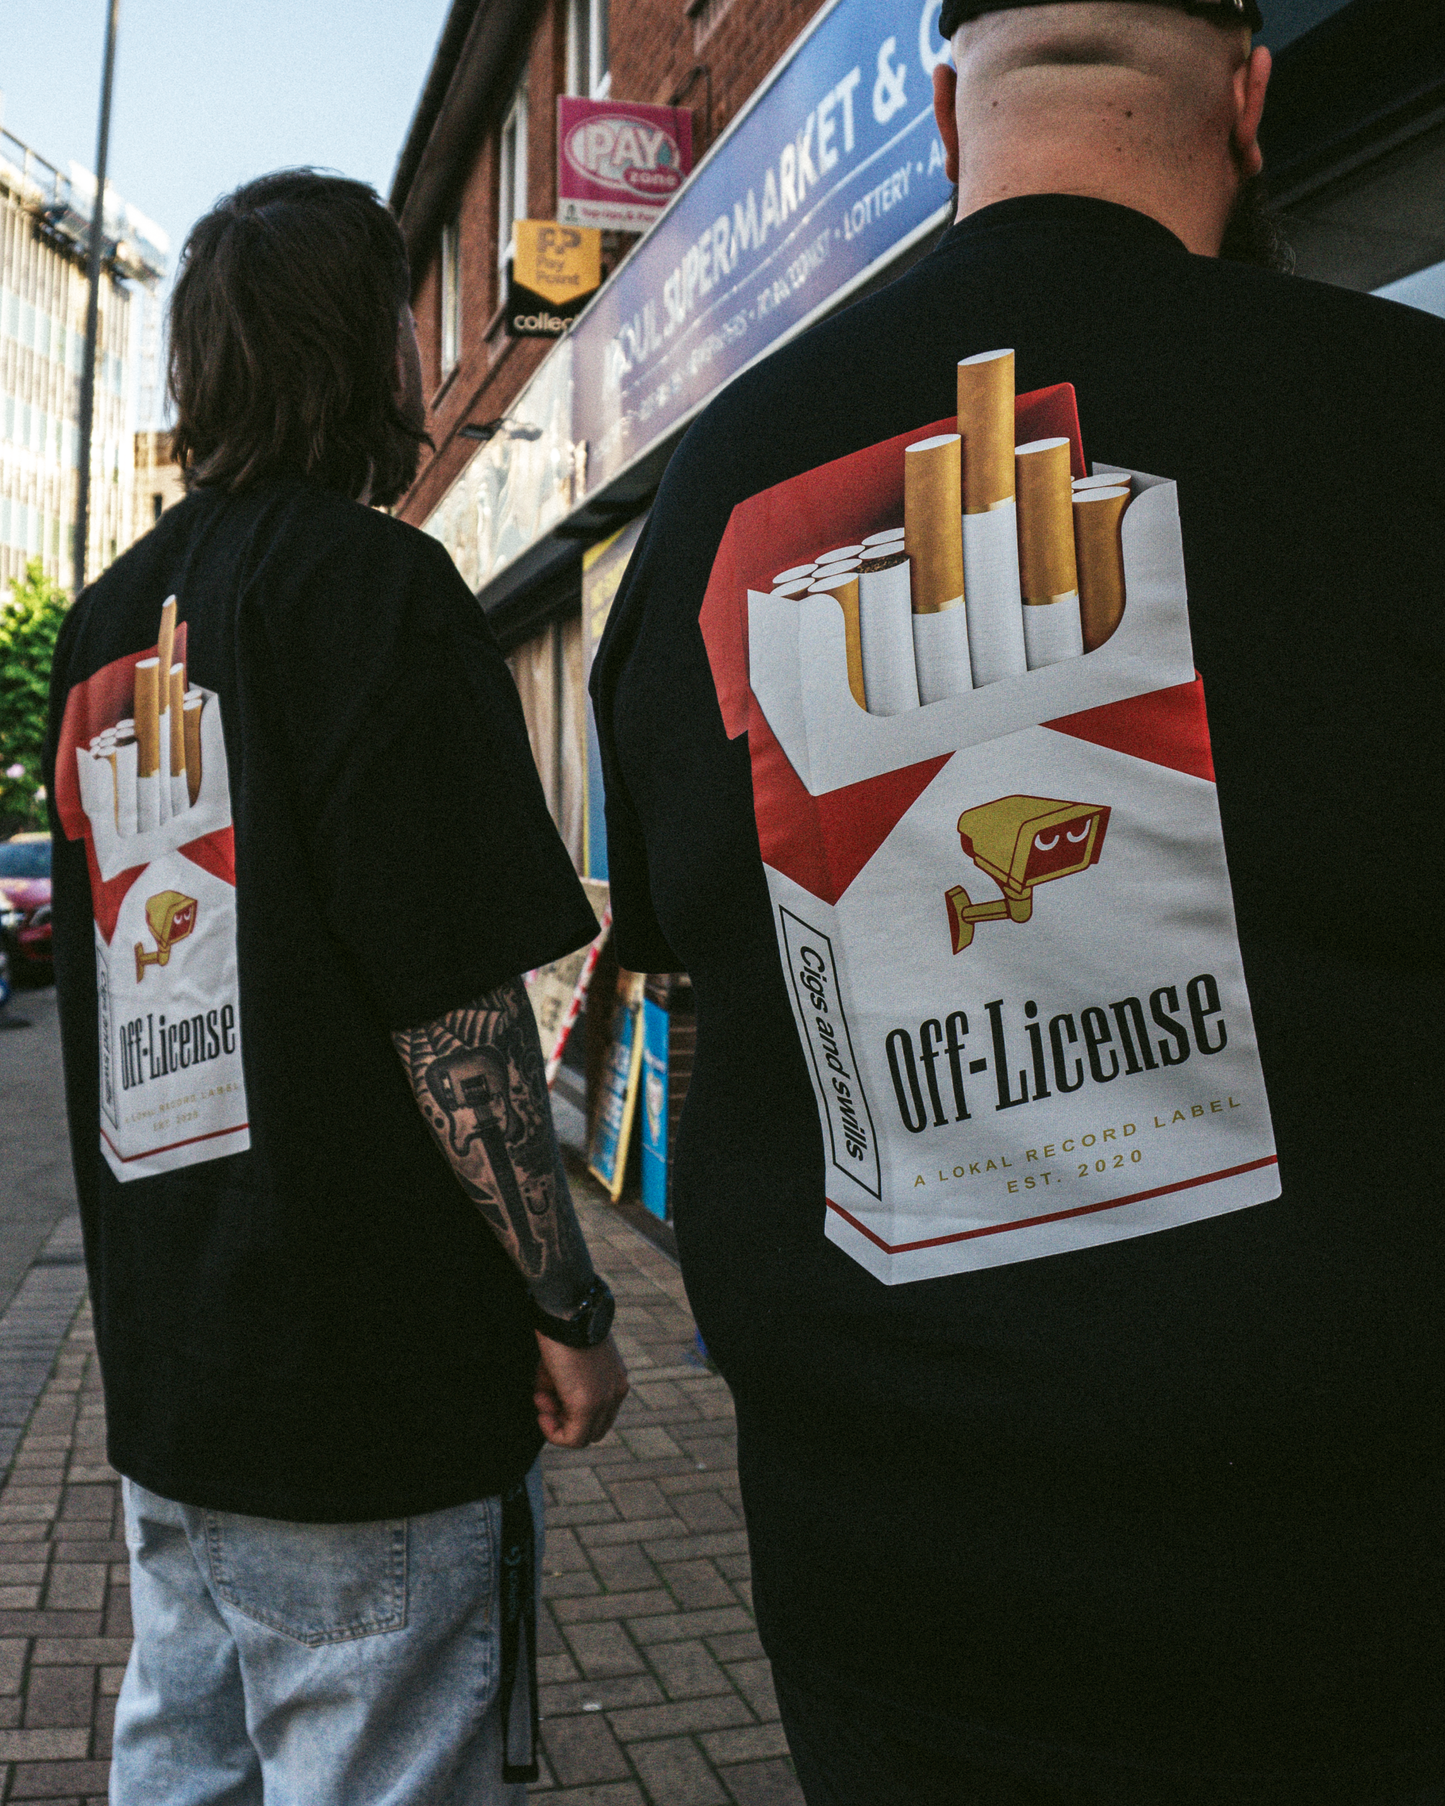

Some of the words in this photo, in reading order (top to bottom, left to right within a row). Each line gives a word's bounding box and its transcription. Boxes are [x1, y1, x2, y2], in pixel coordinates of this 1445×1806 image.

[584, 123, 664, 171] PAY
[663, 64, 862, 338] SUPERMARKET
[872, 36, 907, 125] &
[844, 161, 912, 241] LOTTERY
[536, 253, 565, 273] Pay
[536, 271, 580, 286] Point
[513, 312, 580, 331] collec
[800, 945, 829, 1015] Cigs
[119, 1003, 236, 1091] Off-License
[814, 1016, 850, 1079] and
[885, 973, 1229, 1134] Off-License
[831, 1077, 868, 1162] swills
[913, 1175, 925, 1187] A
[938, 1155, 1013, 1183] LOKAL
[1026, 1123, 1138, 1162] RECORD
[1154, 1097, 1242, 1129] LABEL
[1007, 1174, 1062, 1195] EST.
[1078, 1150, 1144, 1178] 2020
